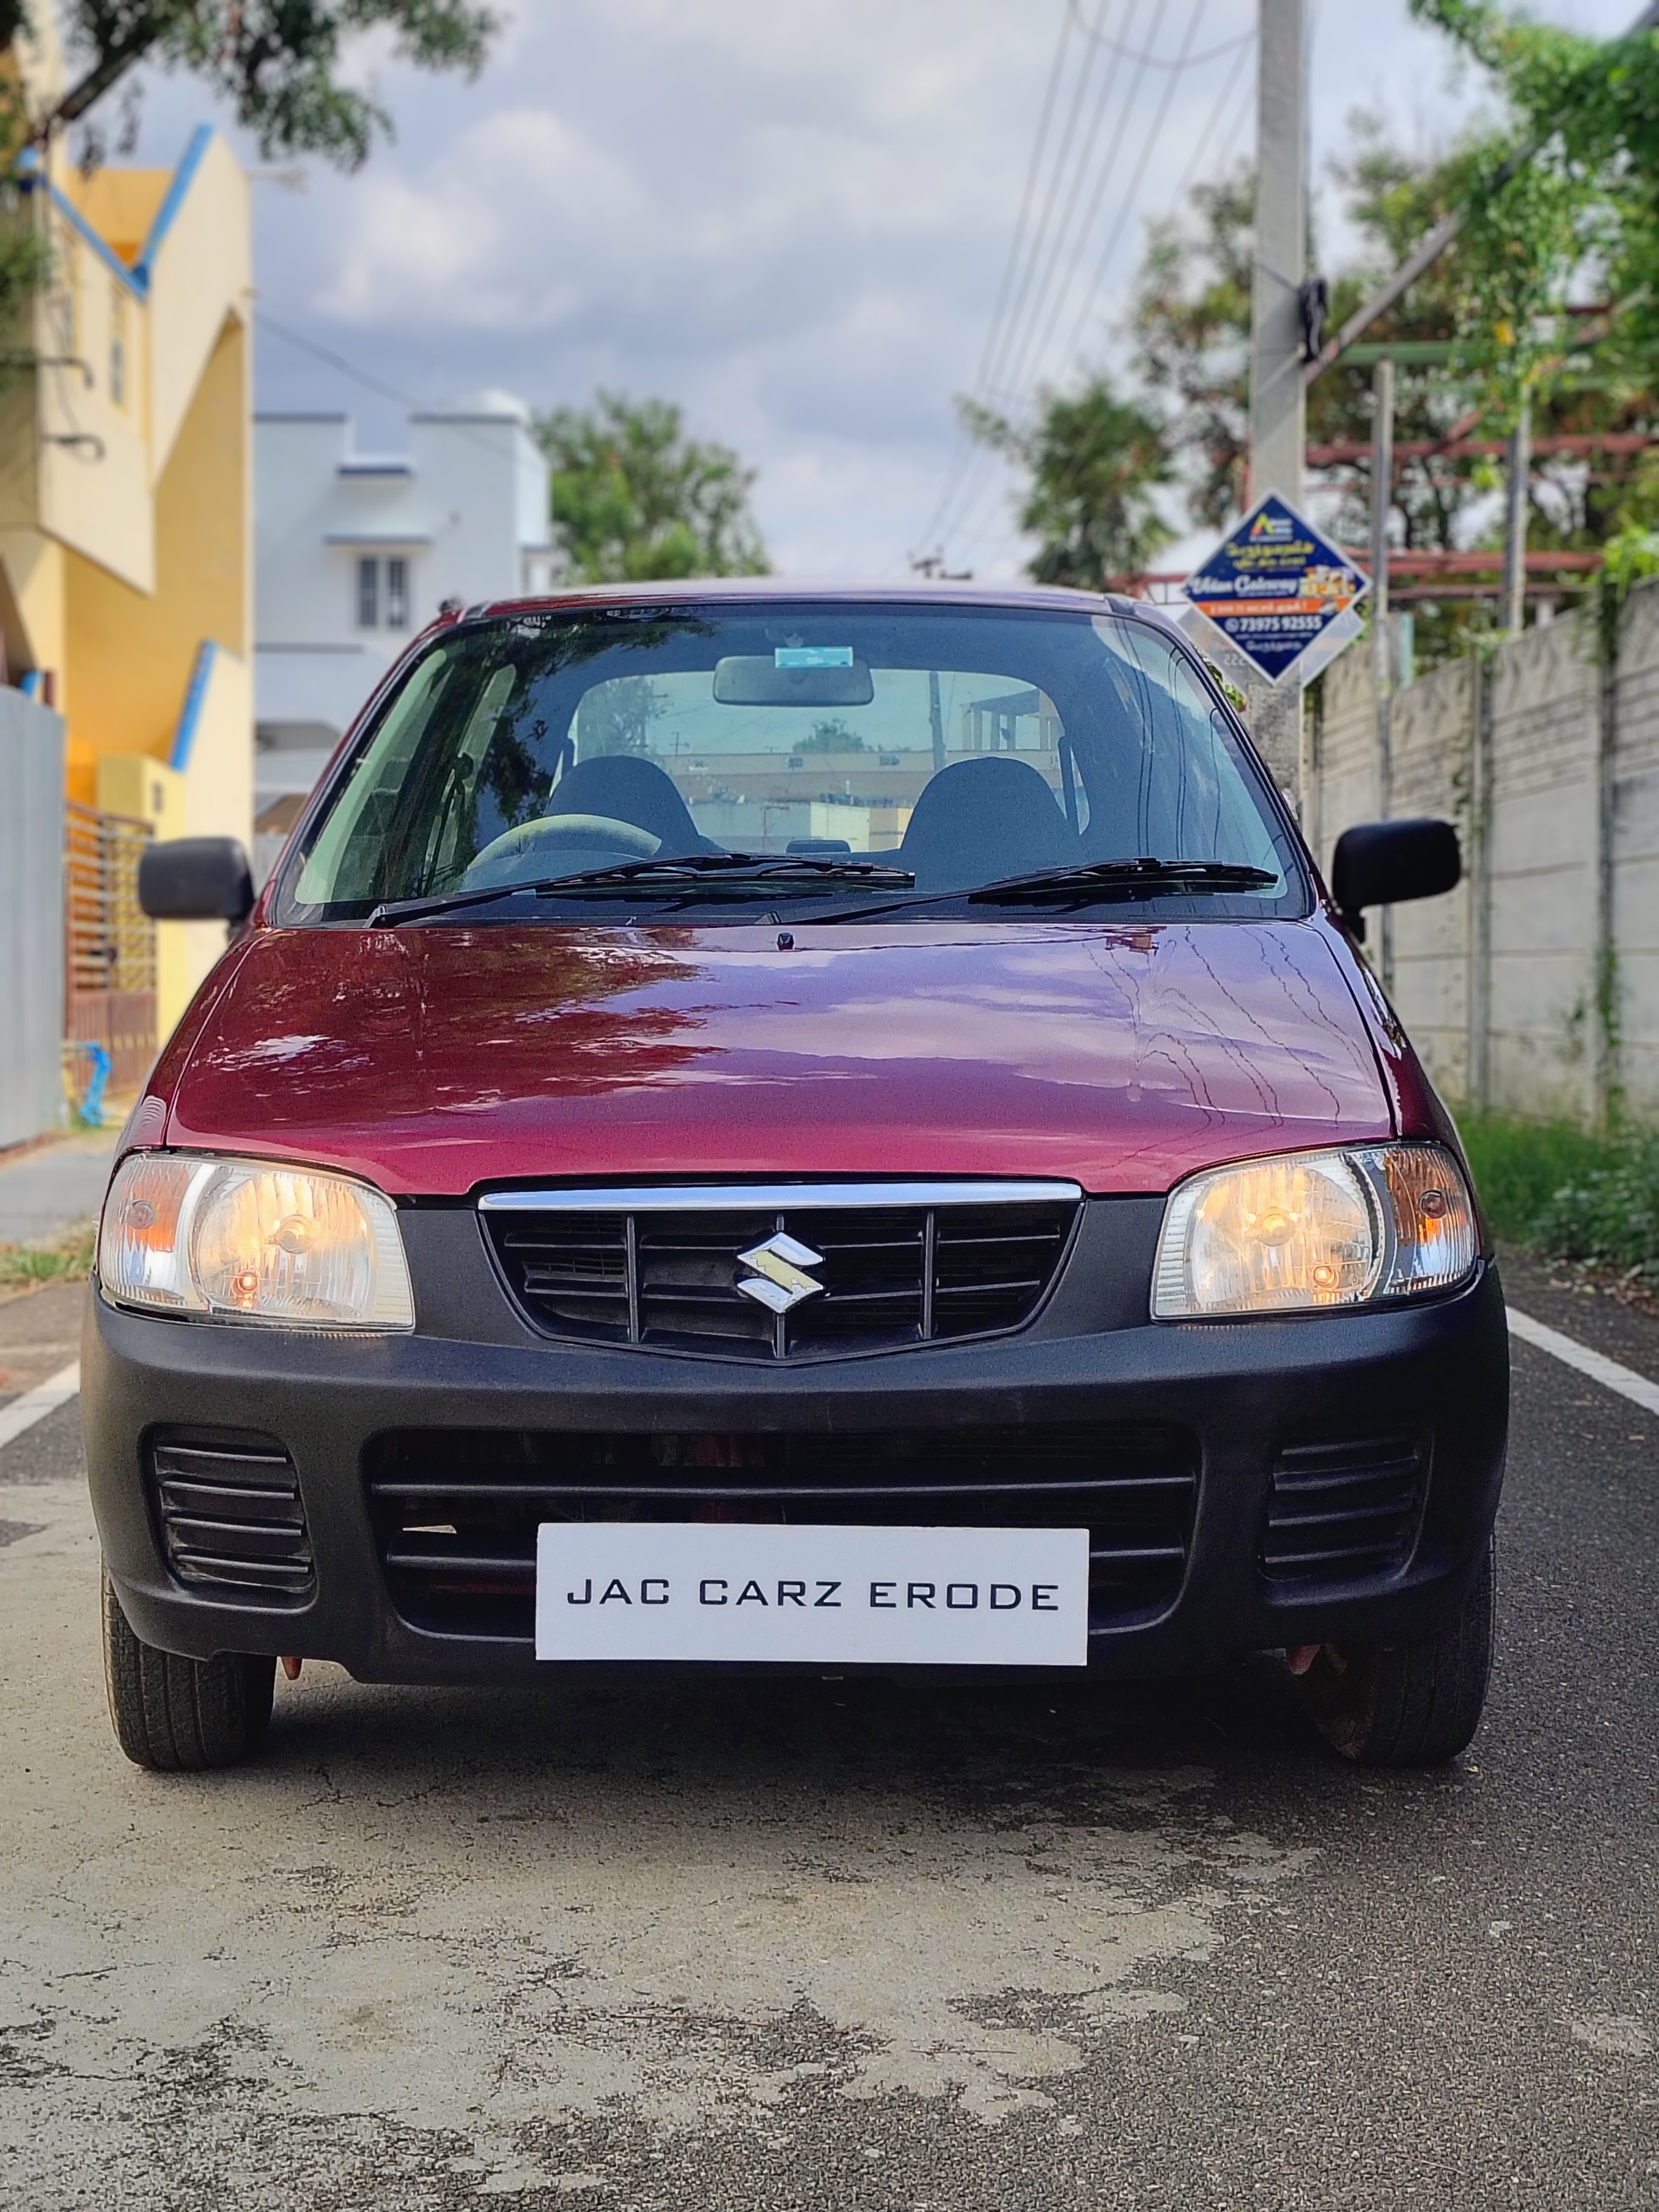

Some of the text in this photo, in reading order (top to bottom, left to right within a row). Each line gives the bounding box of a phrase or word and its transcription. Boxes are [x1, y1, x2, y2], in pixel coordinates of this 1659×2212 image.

[567, 1579, 1058, 1611] JAC CARZ ERODE
